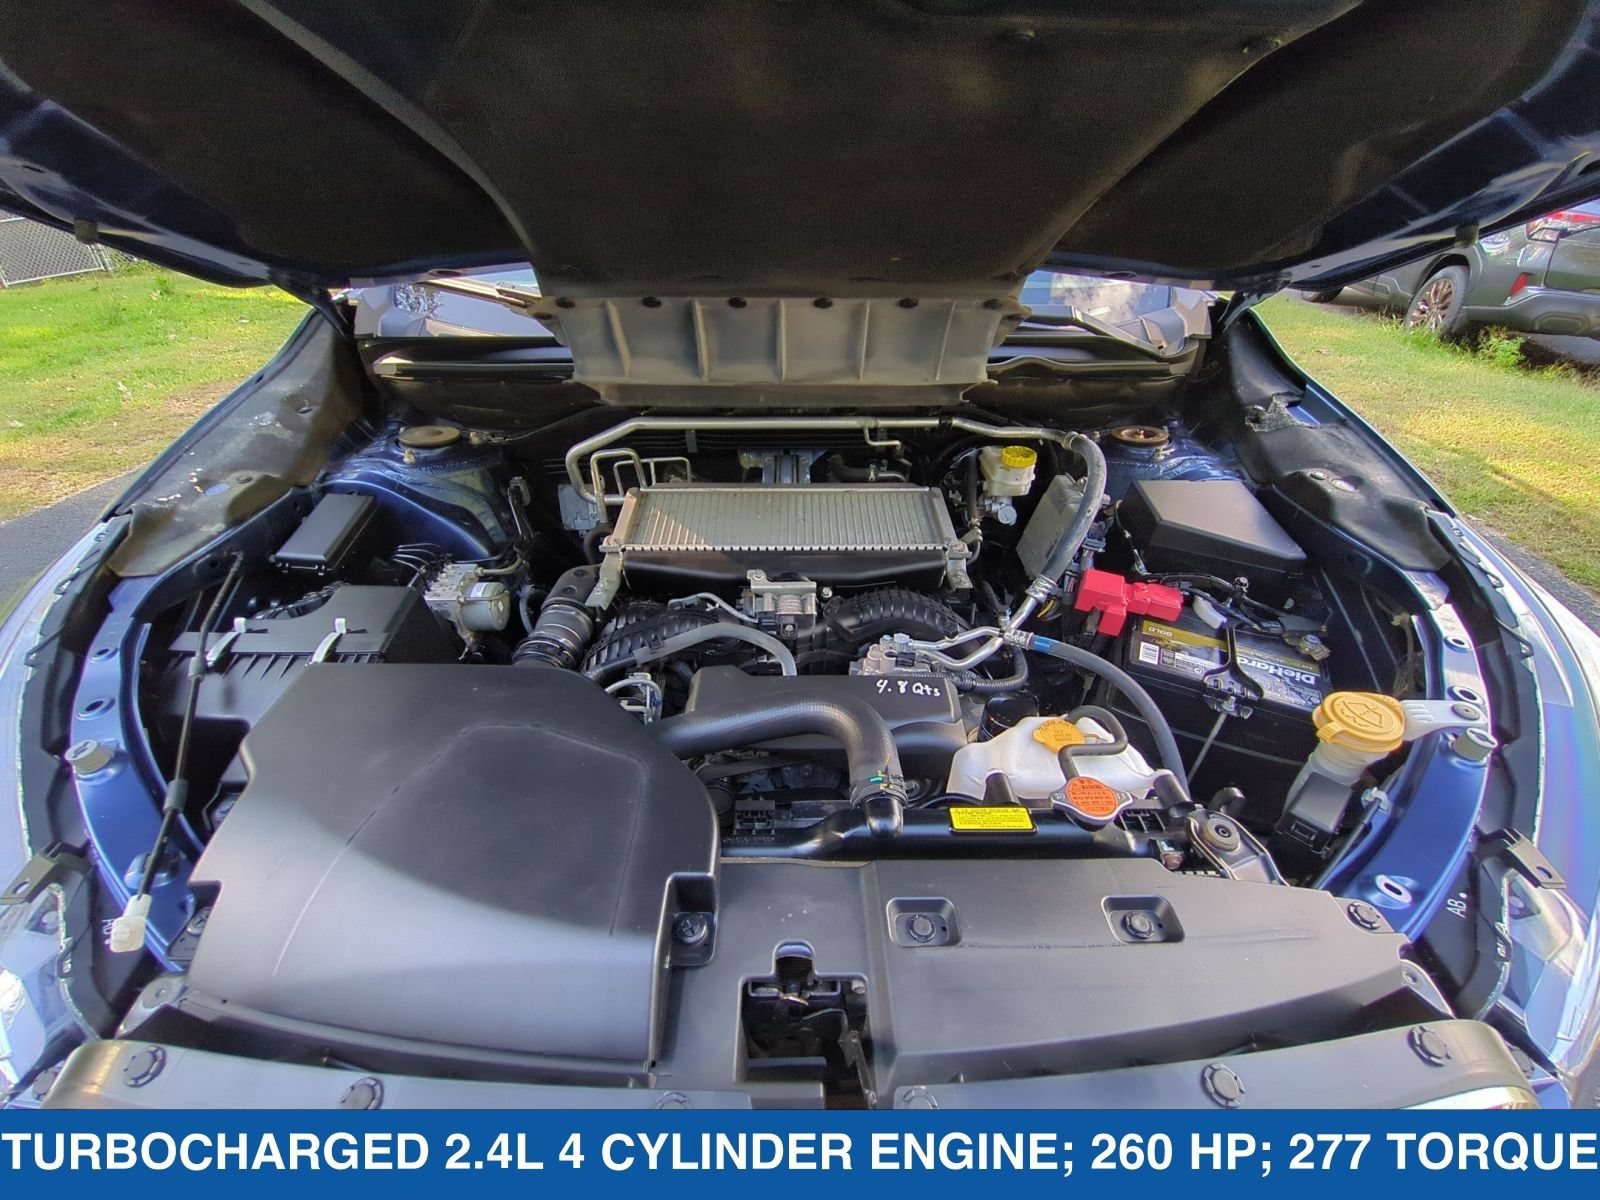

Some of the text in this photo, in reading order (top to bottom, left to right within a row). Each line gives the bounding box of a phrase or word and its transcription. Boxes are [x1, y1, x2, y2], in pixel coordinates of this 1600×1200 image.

[1148, 626, 1173, 637] GOLD
[1236, 655, 1316, 685] DieHard
[912, 682, 941, 697] Qts
